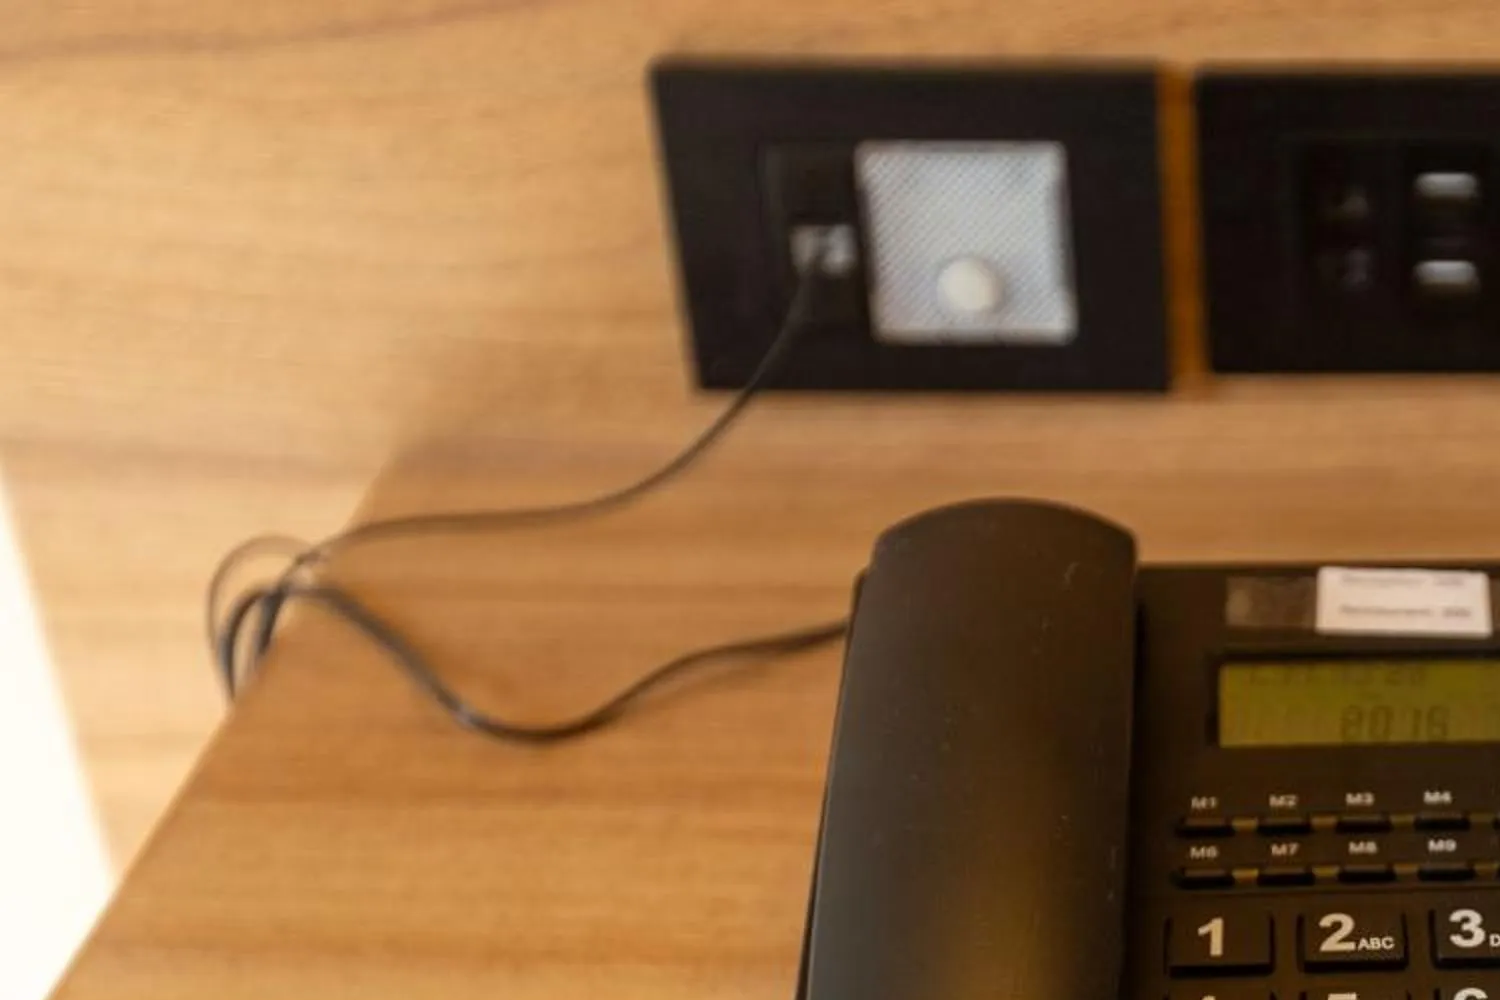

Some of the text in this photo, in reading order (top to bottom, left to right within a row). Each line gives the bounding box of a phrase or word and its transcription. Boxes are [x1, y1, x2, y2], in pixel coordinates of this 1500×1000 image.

[1191, 796, 1218, 810] M1
[1269, 794, 1297, 808] M2
[1345, 792, 1375, 806] M3
[1423, 790, 1452, 804] M4
[1271, 842, 1299, 856] M7
[1428, 839, 1457, 852] M9
[1319, 913, 1395, 952] 2 ABC
[1449, 909, 1486, 948] 3
[1197, 917, 1224, 957] 1
